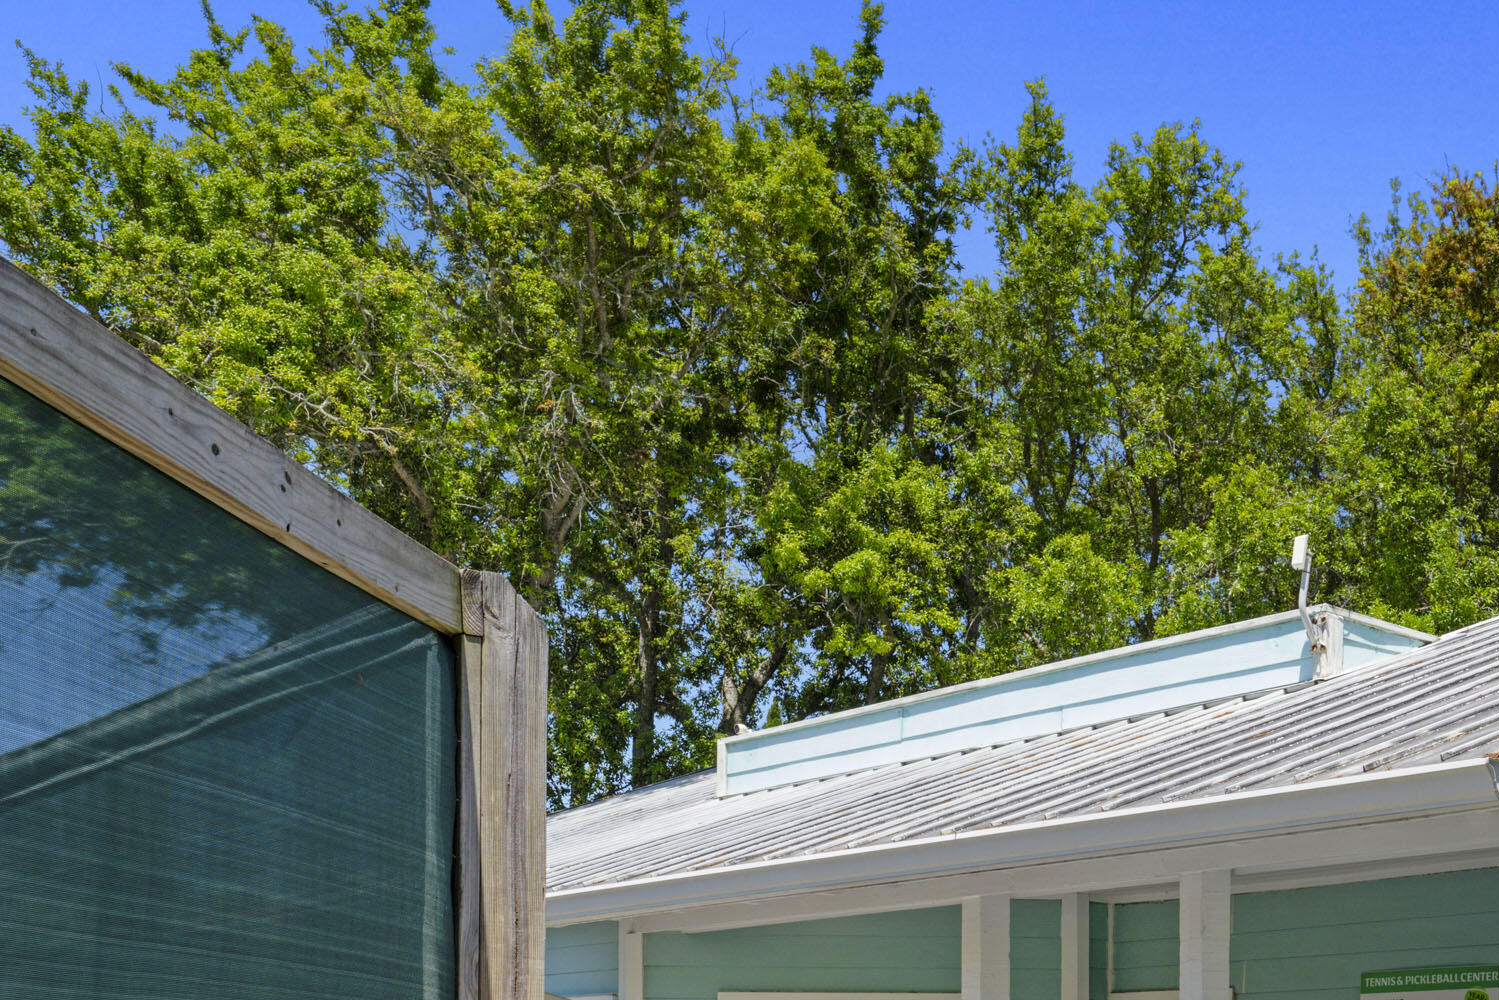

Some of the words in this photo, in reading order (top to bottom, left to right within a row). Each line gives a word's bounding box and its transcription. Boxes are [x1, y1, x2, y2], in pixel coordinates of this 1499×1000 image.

[1365, 977, 1396, 987] TENNIS
[1397, 976, 1404, 985] &
[1405, 973, 1459, 985] PICKLEBALL
[1459, 971, 1498, 982] CENTER
